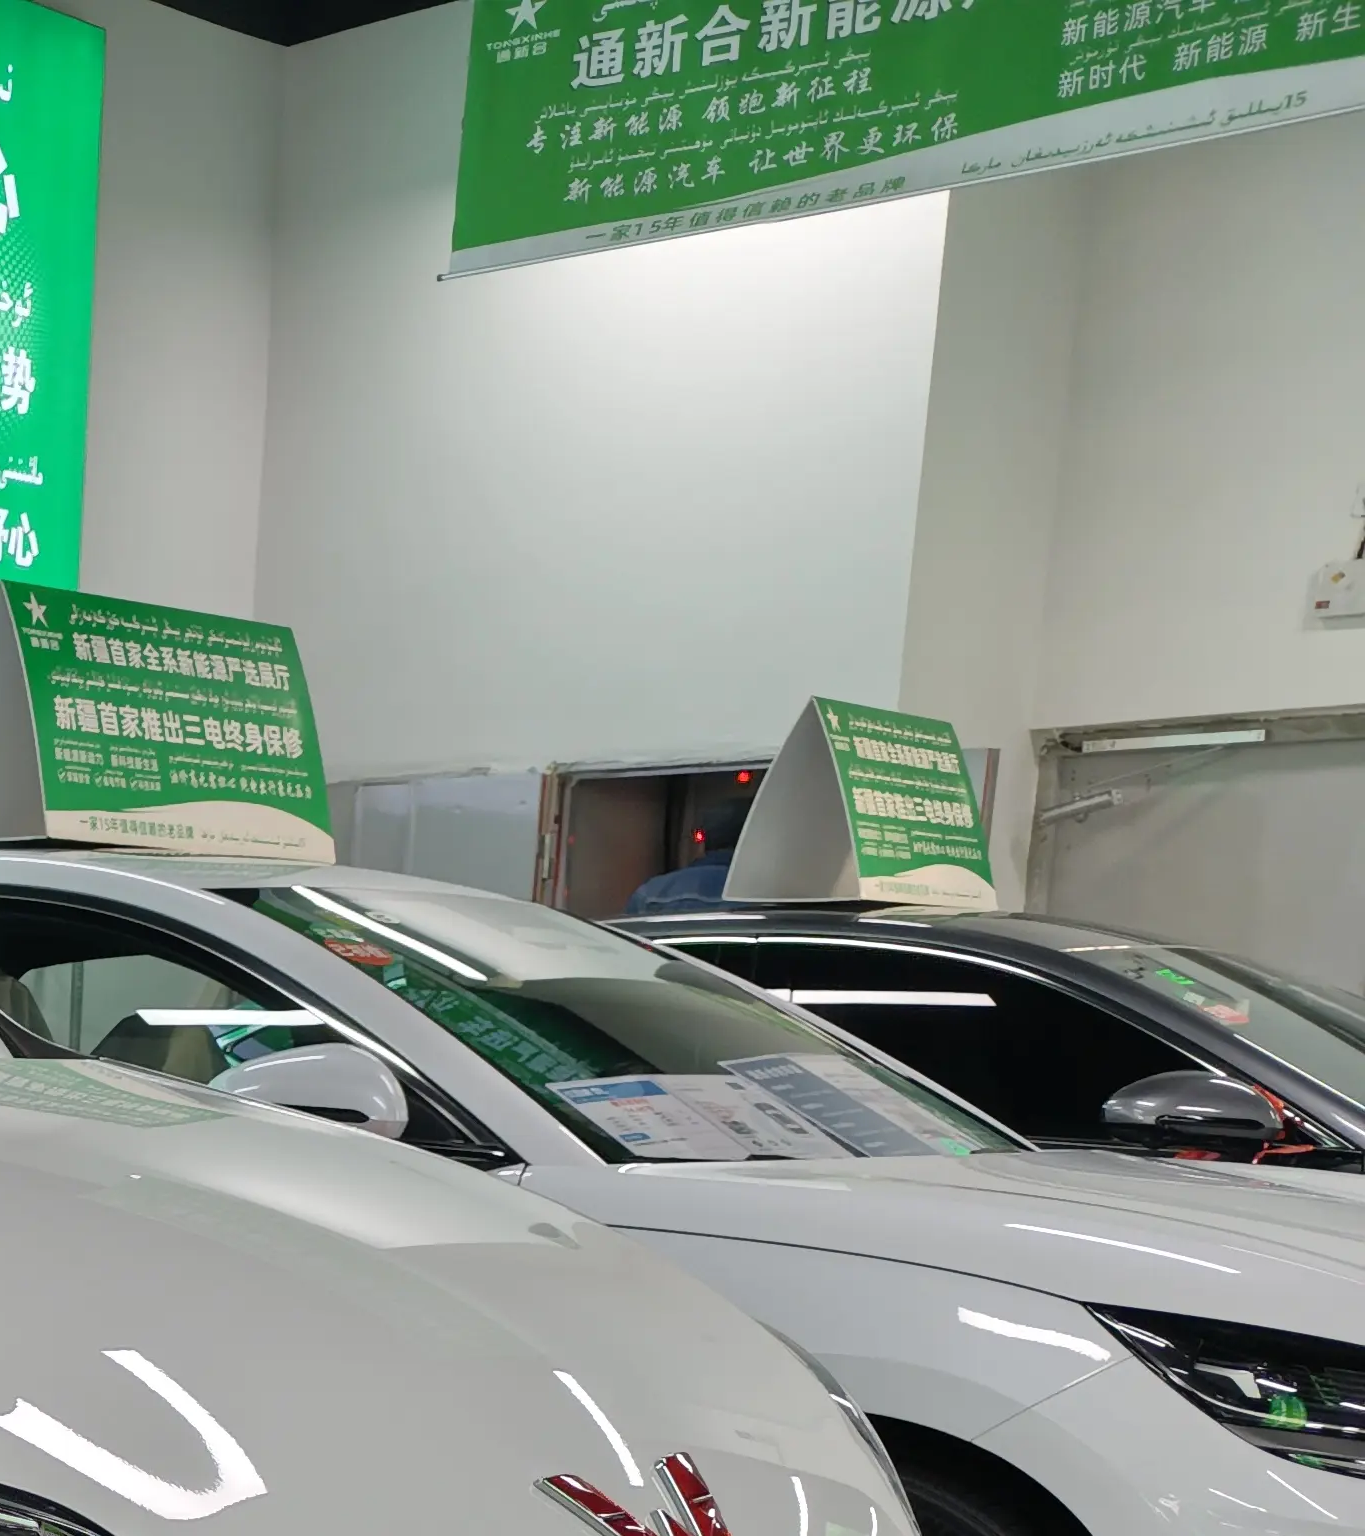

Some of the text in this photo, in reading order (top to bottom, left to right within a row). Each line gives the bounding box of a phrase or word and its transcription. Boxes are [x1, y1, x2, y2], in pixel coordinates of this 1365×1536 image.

[1057, 53, 1147, 98] 新时代
[1173, 23, 1268, 72] 新能源
[527, 67, 871, 154] 专注新能源 领跑新征程
[563, 112, 959, 204] 新能源汽车 让世界更环保
[585, 175, 906, 243] 一家15年值得信赖的老品牌
[53, 695, 303, 758] 新疆首家推出三电终身保修
